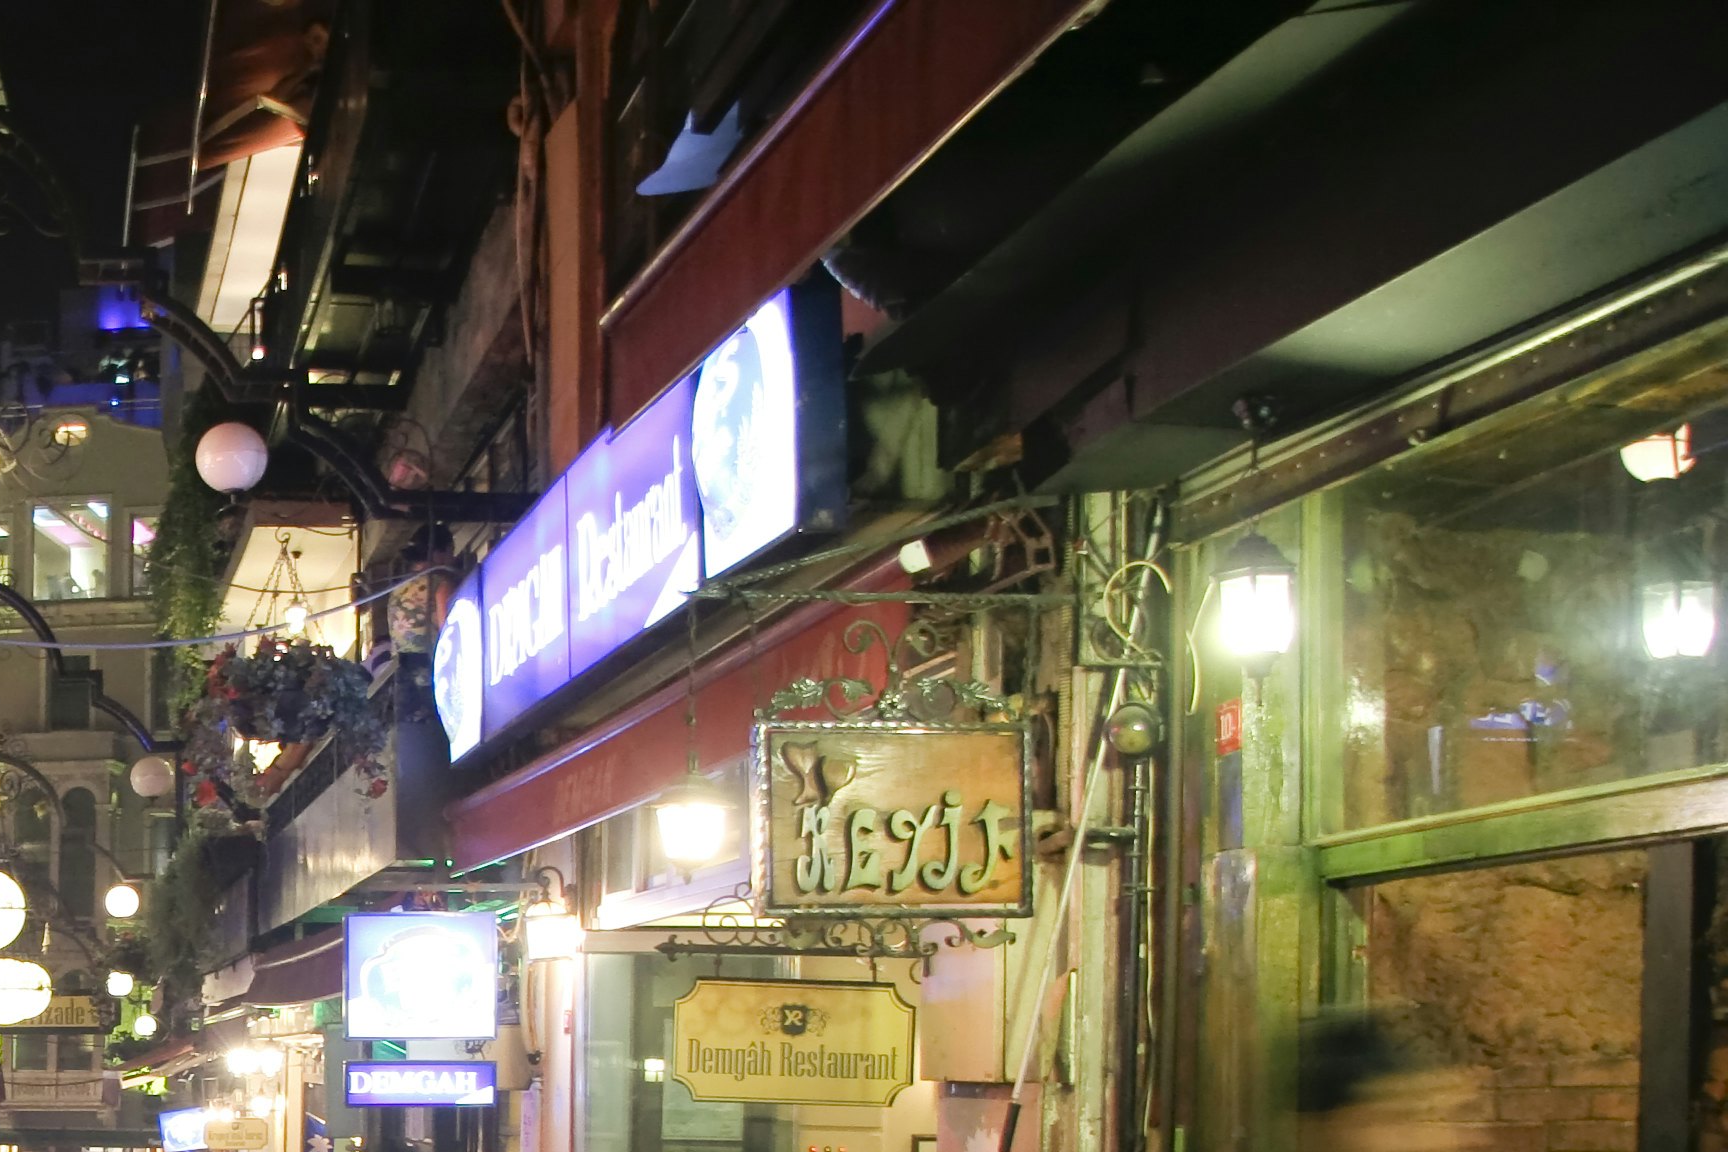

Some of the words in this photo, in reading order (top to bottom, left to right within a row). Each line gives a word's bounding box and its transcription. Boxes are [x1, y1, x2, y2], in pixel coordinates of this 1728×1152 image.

[577, 434, 687, 622] Restaurant
[687, 1038, 771, 1081] Demgâh
[779, 1042, 897, 1080] Restaurant
[348, 1071, 477, 1094] DEMGAH
